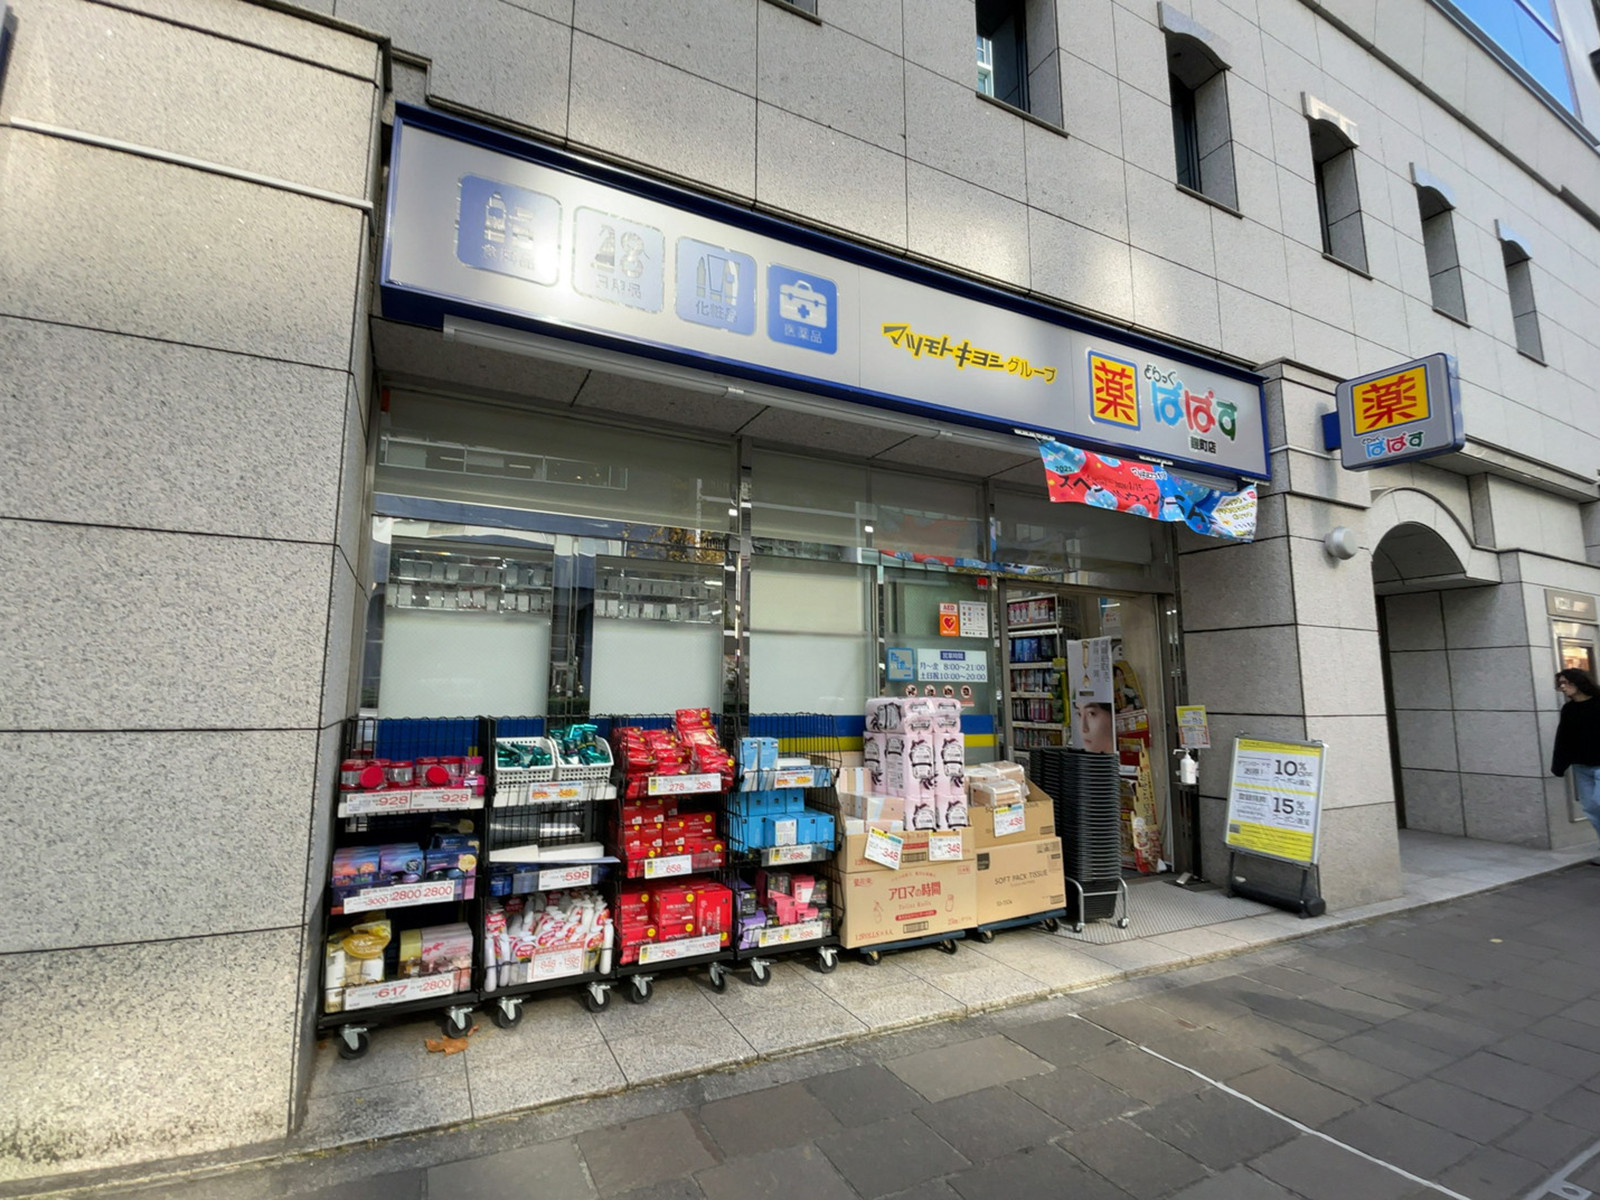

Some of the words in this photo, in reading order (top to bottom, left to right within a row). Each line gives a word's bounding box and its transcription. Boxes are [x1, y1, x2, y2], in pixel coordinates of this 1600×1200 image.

[695, 301, 738, 323] 化粧品
[784, 323, 823, 344] 医薬品
[1094, 361, 1135, 422] 薬
[1361, 374, 1417, 429] 薬
[1151, 381, 1238, 441] ぱぱす
[1365, 431, 1425, 458] ぱぱす
[1275, 760, 1298, 776] 10
[379, 795, 409, 806] 928
[441, 794, 469, 803] 928
[1272, 797, 1295, 815] 15
[565, 870, 590, 881] 598
[391, 889, 422, 901] 2800
[424, 886, 452, 897] 2800
[888, 881, 942, 901] アロマの時間
[378, 985, 408, 998] 617
[422, 979, 451, 991] 2800
